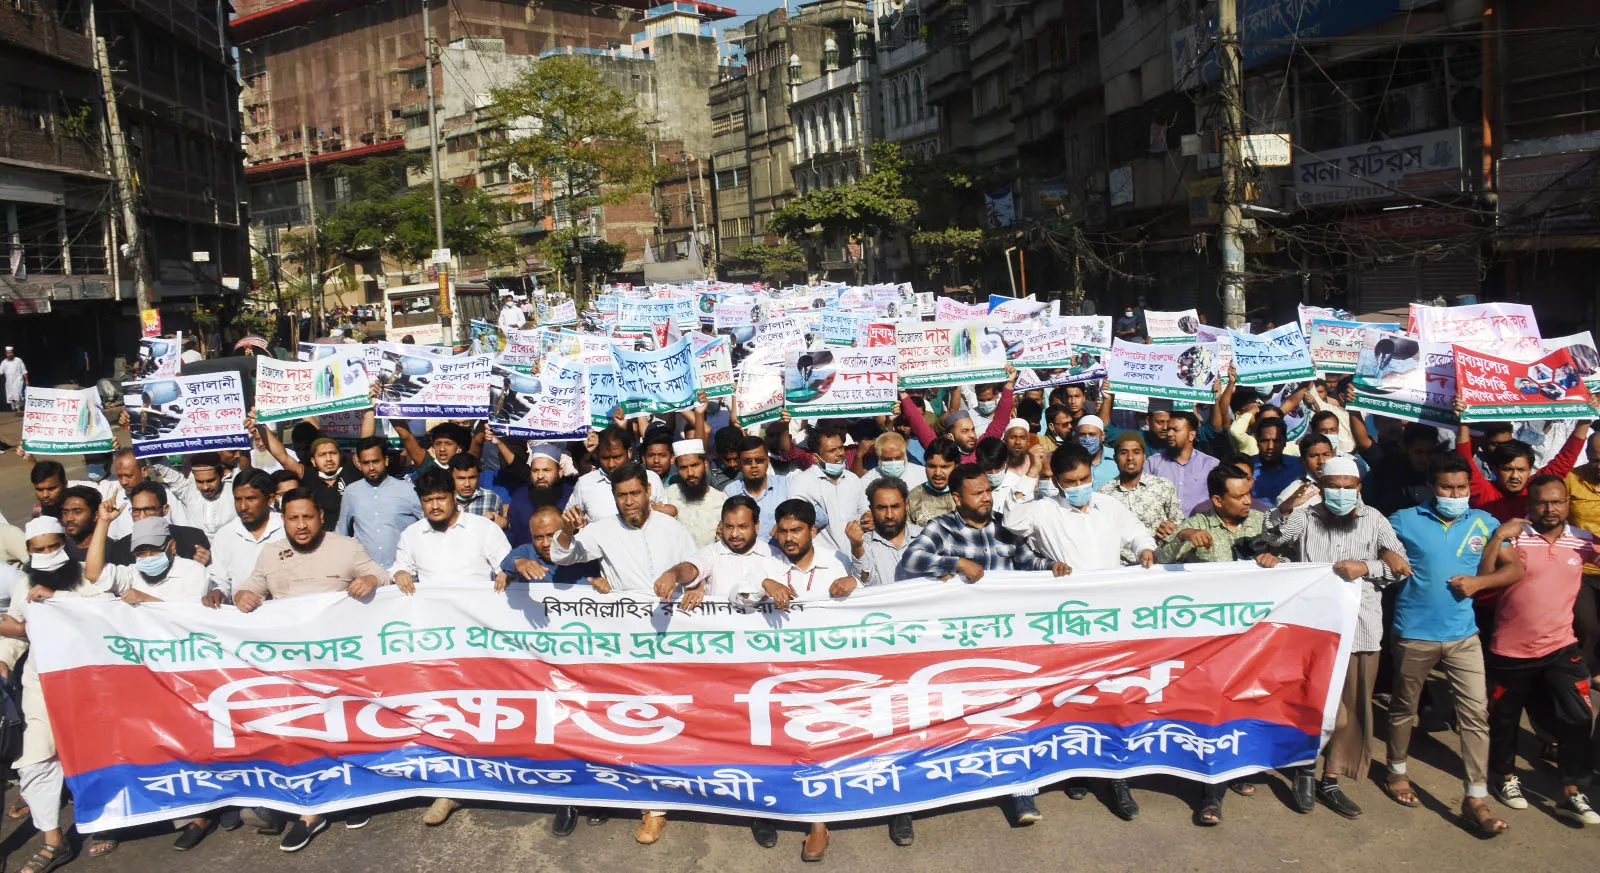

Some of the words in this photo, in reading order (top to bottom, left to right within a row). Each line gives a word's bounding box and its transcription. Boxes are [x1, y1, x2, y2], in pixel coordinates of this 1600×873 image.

[1300, 158, 1342, 184] মনা
[1490, 314, 1528, 329] দরকার
[924, 328, 950, 343] দাম
[897, 347, 930, 357] কমাতে
[932, 345, 950, 356] হবে
[1030, 338, 1066, 352] দাম
[1113, 346, 1147, 361] লুটপাটের
[439, 357, 492, 373] জ্বালানী
[1123, 360, 1146, 370] লড়তে
[1148, 363, 1164, 372] হবে
[285, 368, 313, 382] দাম
[434, 372, 469, 381] তেলের
[703, 371, 730, 384] সরকার
[840, 371, 897, 384] দাম
[1123, 371, 1155, 380] একসাথে
[185, 376, 235, 394] জ্বালানী
[257, 380, 290, 393] কমাতে
[293, 382, 313, 393] হবে
[432, 382, 456, 394] বৃদ্ধি
[460, 383, 491, 391] কেন?
[56, 397, 80, 412] দাম
[185, 394, 220, 407] তেলের
[223, 392, 241, 404] দাম
[256, 393, 289, 405] কমিয়ে
[291, 395, 311, 403] দাও
[26, 411, 58, 422] কমাতে
[61, 414, 79, 424] হবে
[187, 408, 210, 424] বৃদ্ধি
[216, 407, 242, 419] কেন?
[25, 422, 55, 436] কমিয়ে
[542, 597, 654, 618] বিসমিল্লাহির
[103, 631, 224, 664] জ্বালানি
[235, 634, 364, 663] তেলসহ
[378, 620, 456, 655] নিত্য
[466, 621, 622, 657] প্রয়োজনীয়
[630, 629, 735, 659] দ্রব্যের
[744, 612, 928, 655] অস্বাভাবিক
[938, 613, 1015, 646] মূল্য
[1025, 600, 1121, 643] বৃদ্ধির
[1130, 595, 1274, 629] প্রতিবাদে
[193, 675, 693, 749] বিক্ষোভ
[734, 658, 1185, 746] মিছিল
[138, 763, 354, 796] বাংলাদেশ
[367, 754, 576, 785] জামায়াতে
[586, 761, 777, 807] ইসলামী,
[792, 760, 906, 799] ঢাকা
[915, 725, 1113, 782] মহানগরী
[1122, 723, 1247, 760] দক্ষিণ
